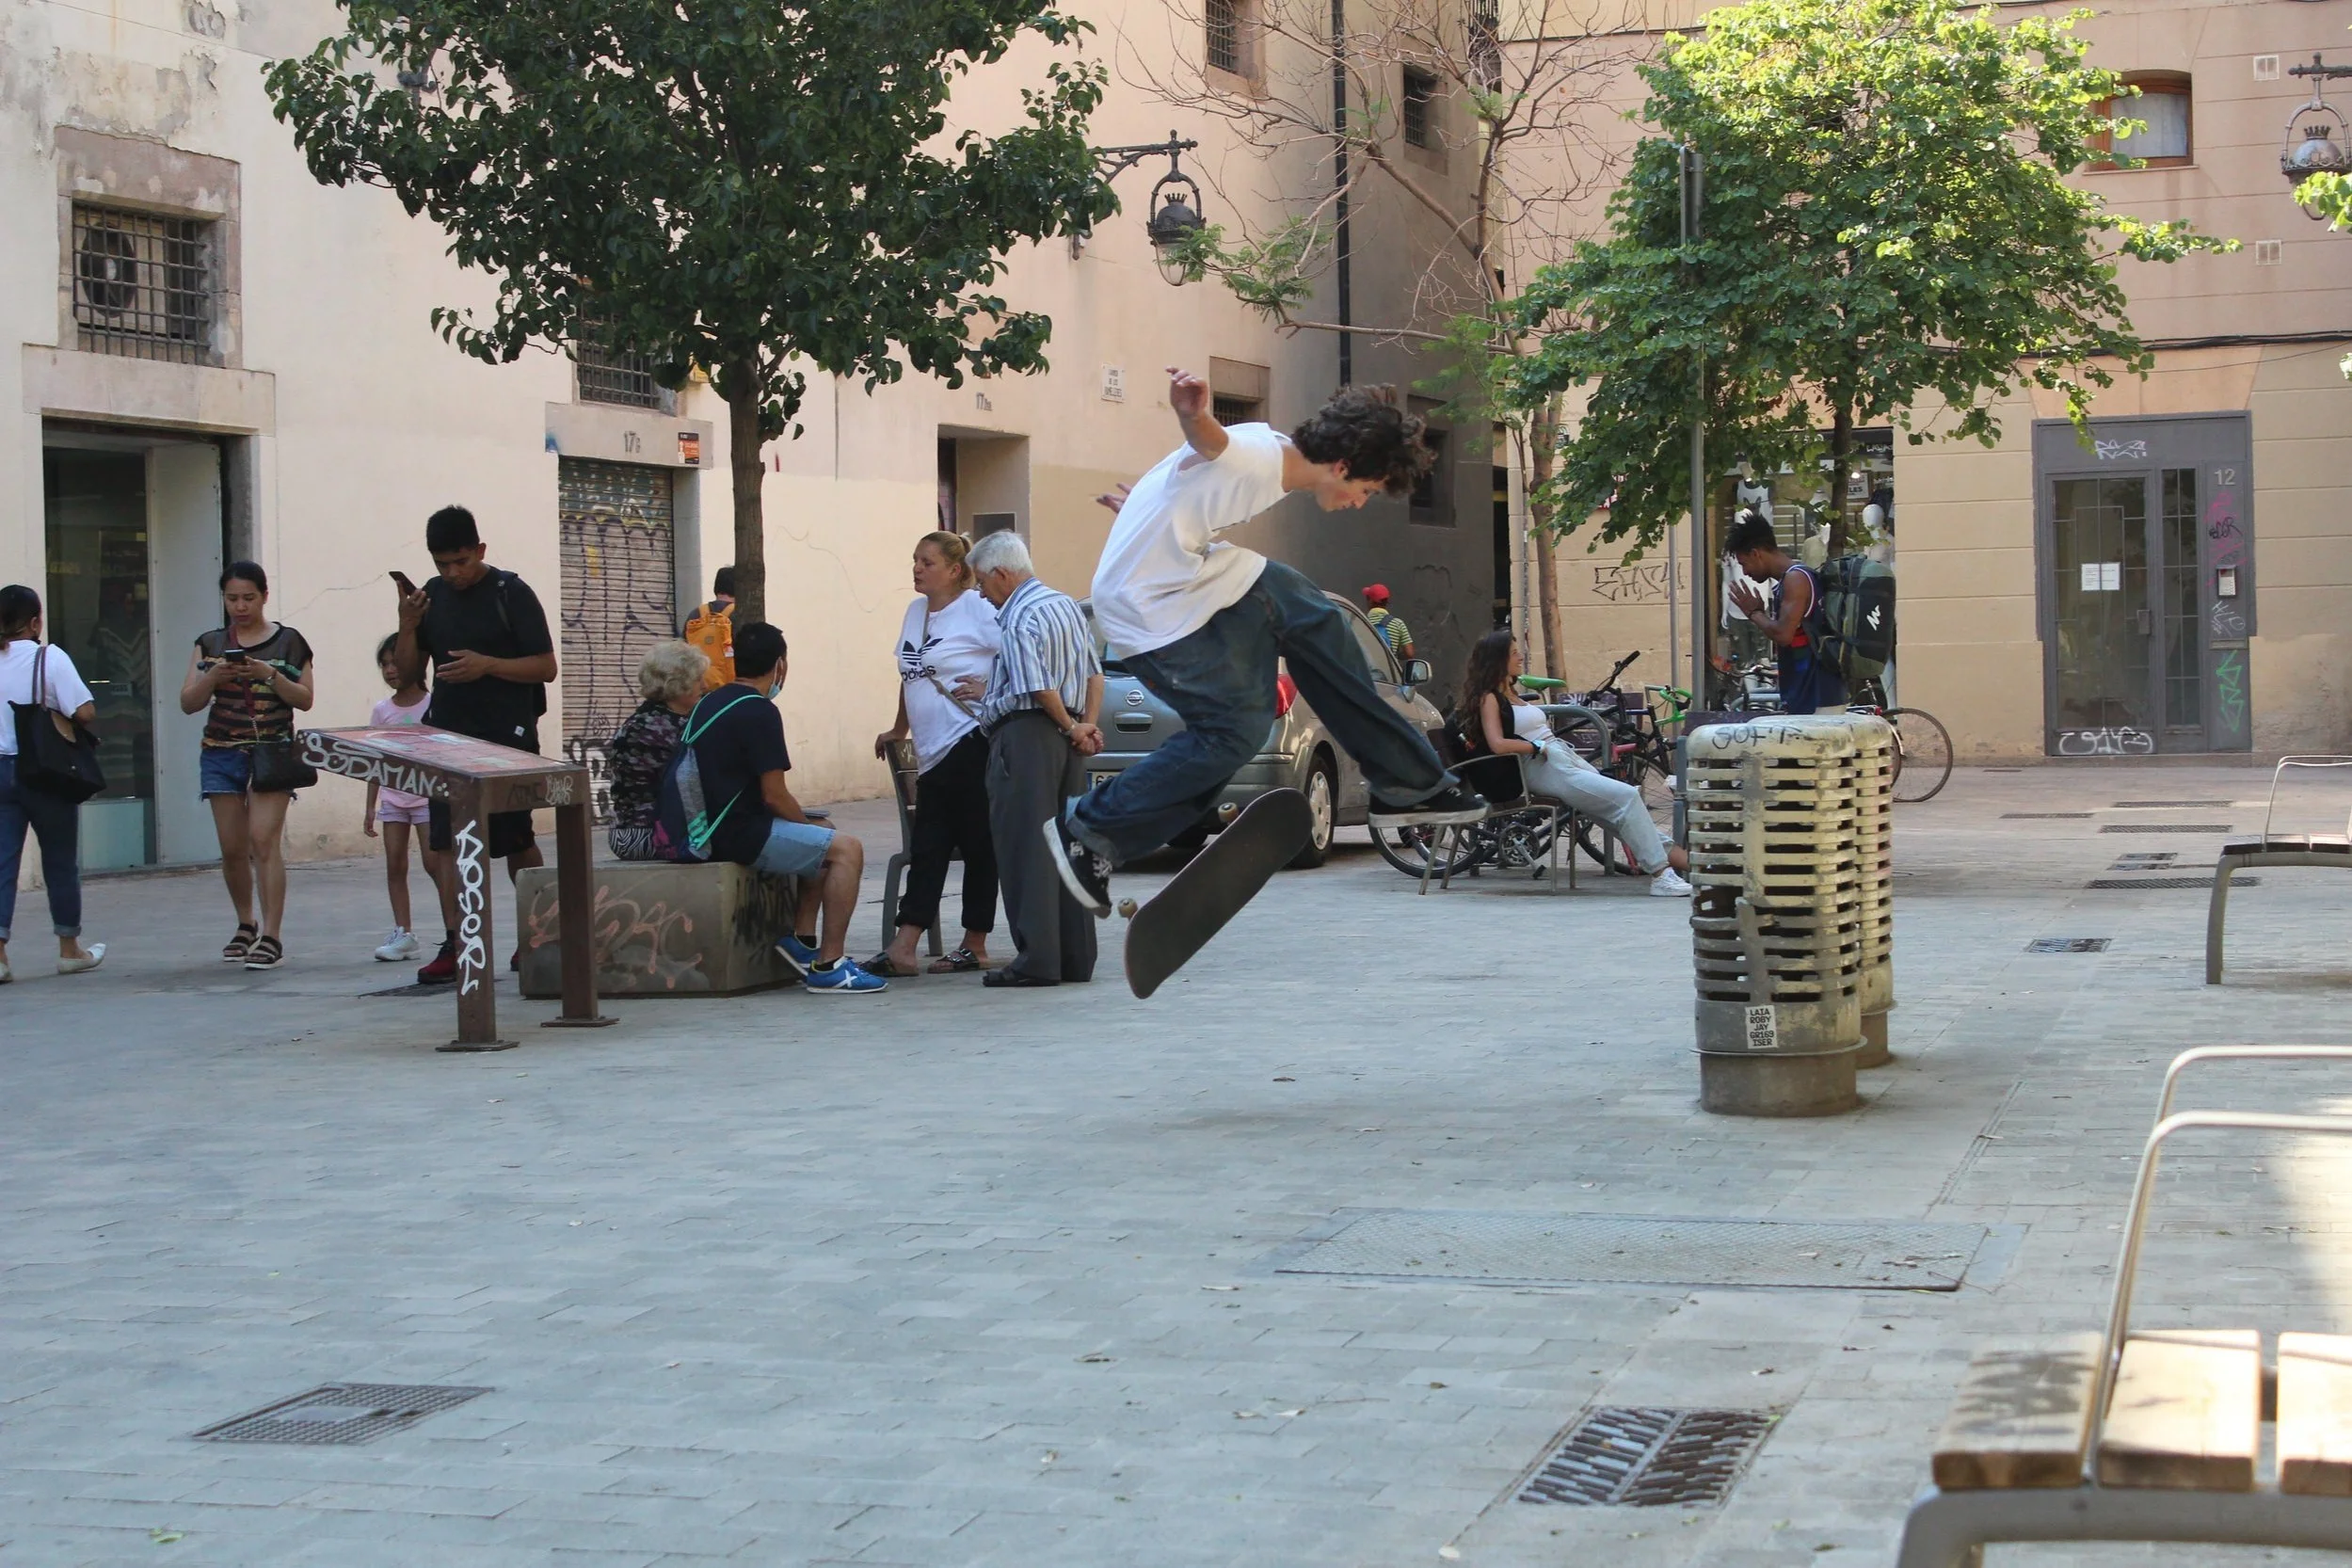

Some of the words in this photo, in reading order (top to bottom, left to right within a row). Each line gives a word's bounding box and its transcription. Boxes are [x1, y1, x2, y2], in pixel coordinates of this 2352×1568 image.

[2214, 469, 2236, 486] 12
[302, 732, 438, 797] SODAMAN
[1750, 1016, 1770, 1024] ROBY
